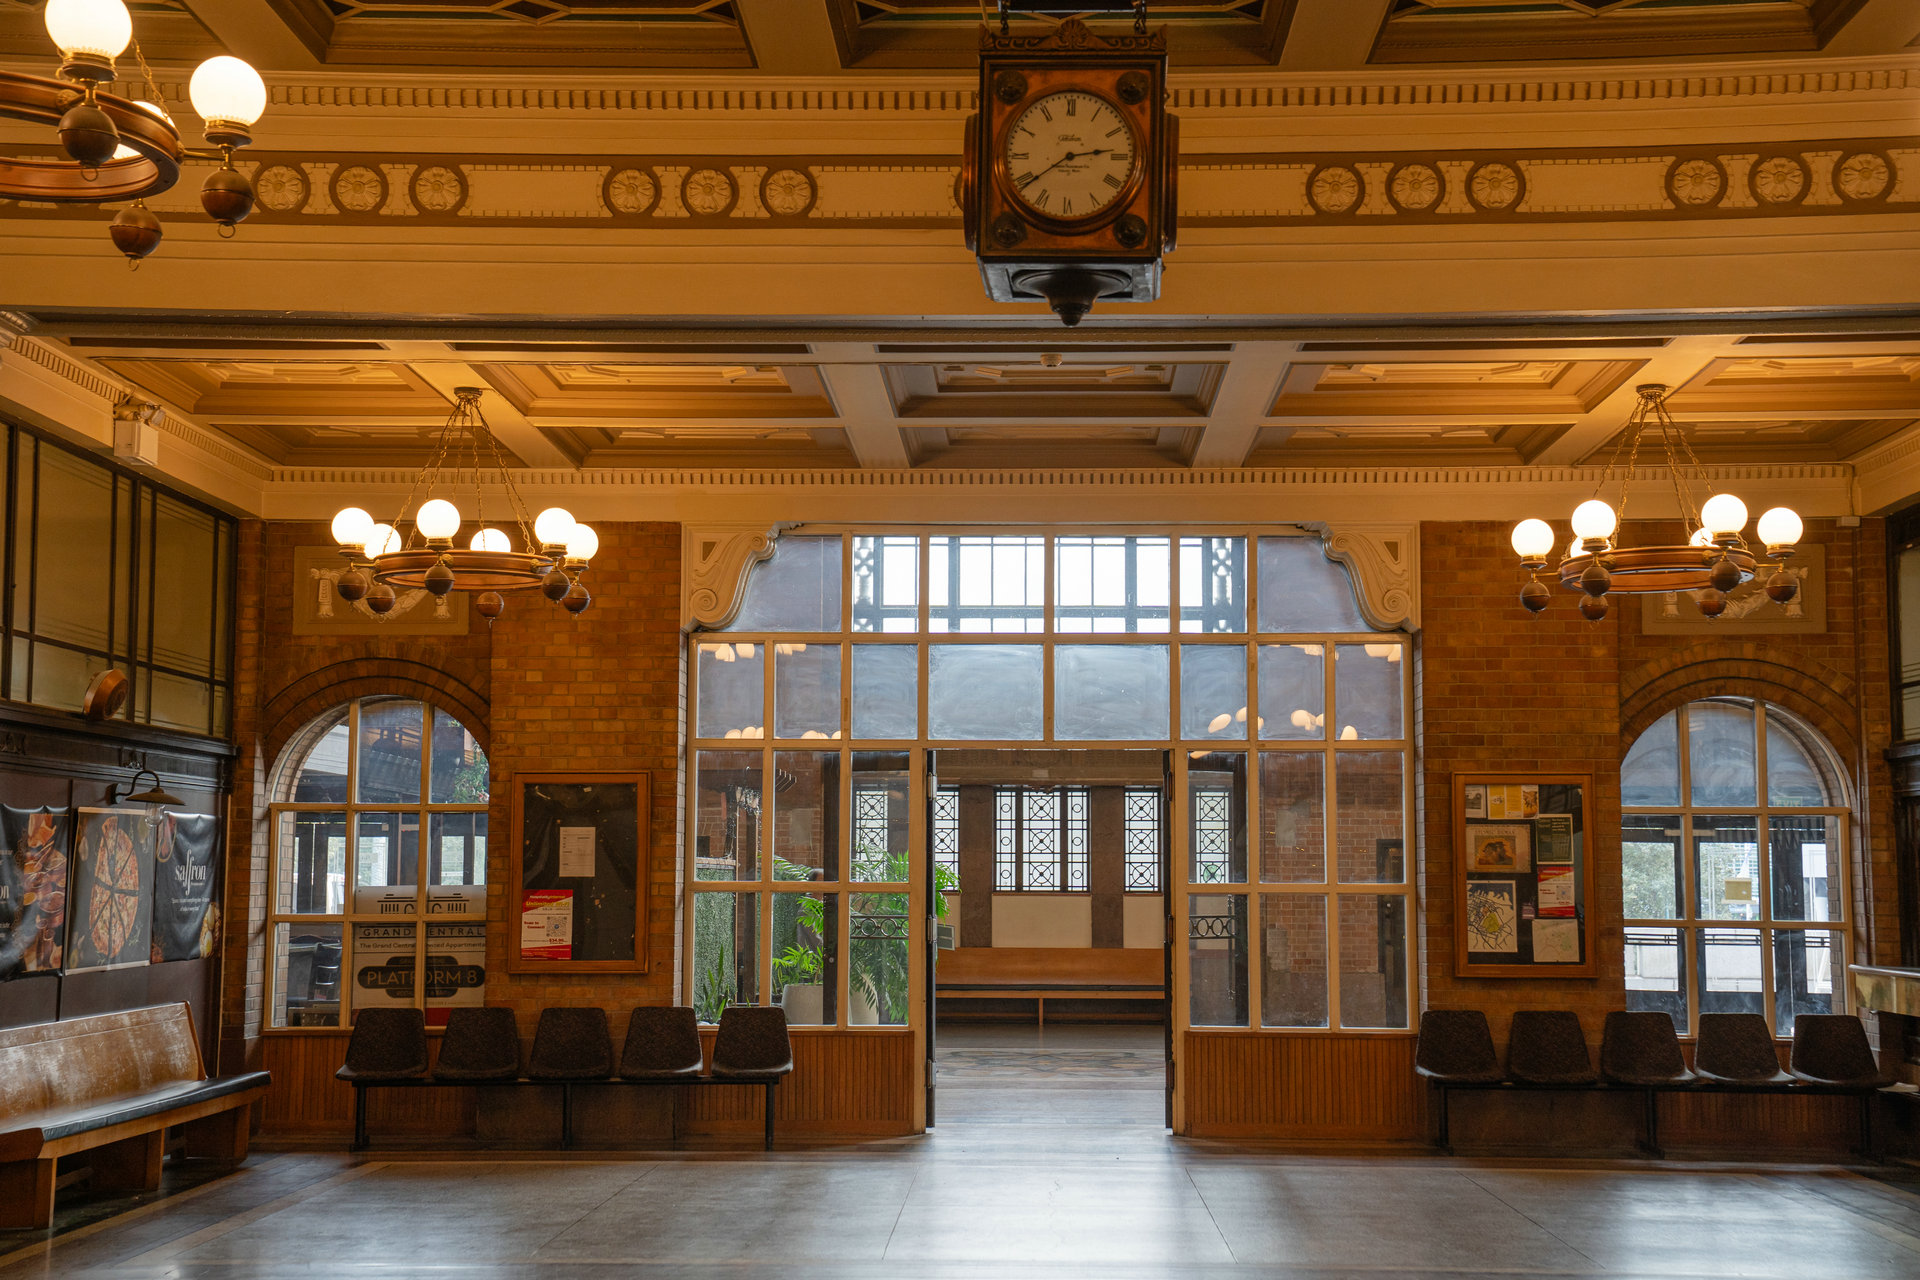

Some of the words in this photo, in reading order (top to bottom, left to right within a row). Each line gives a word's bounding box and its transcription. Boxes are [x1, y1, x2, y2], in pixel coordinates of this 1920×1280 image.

[1066, 99, 1076, 117] XII
[175, 849, 206, 896] saffron
[363, 928, 412, 937] GRAND
[429, 927, 482, 936] ENTRAL
[466, 970, 477, 984] 8
